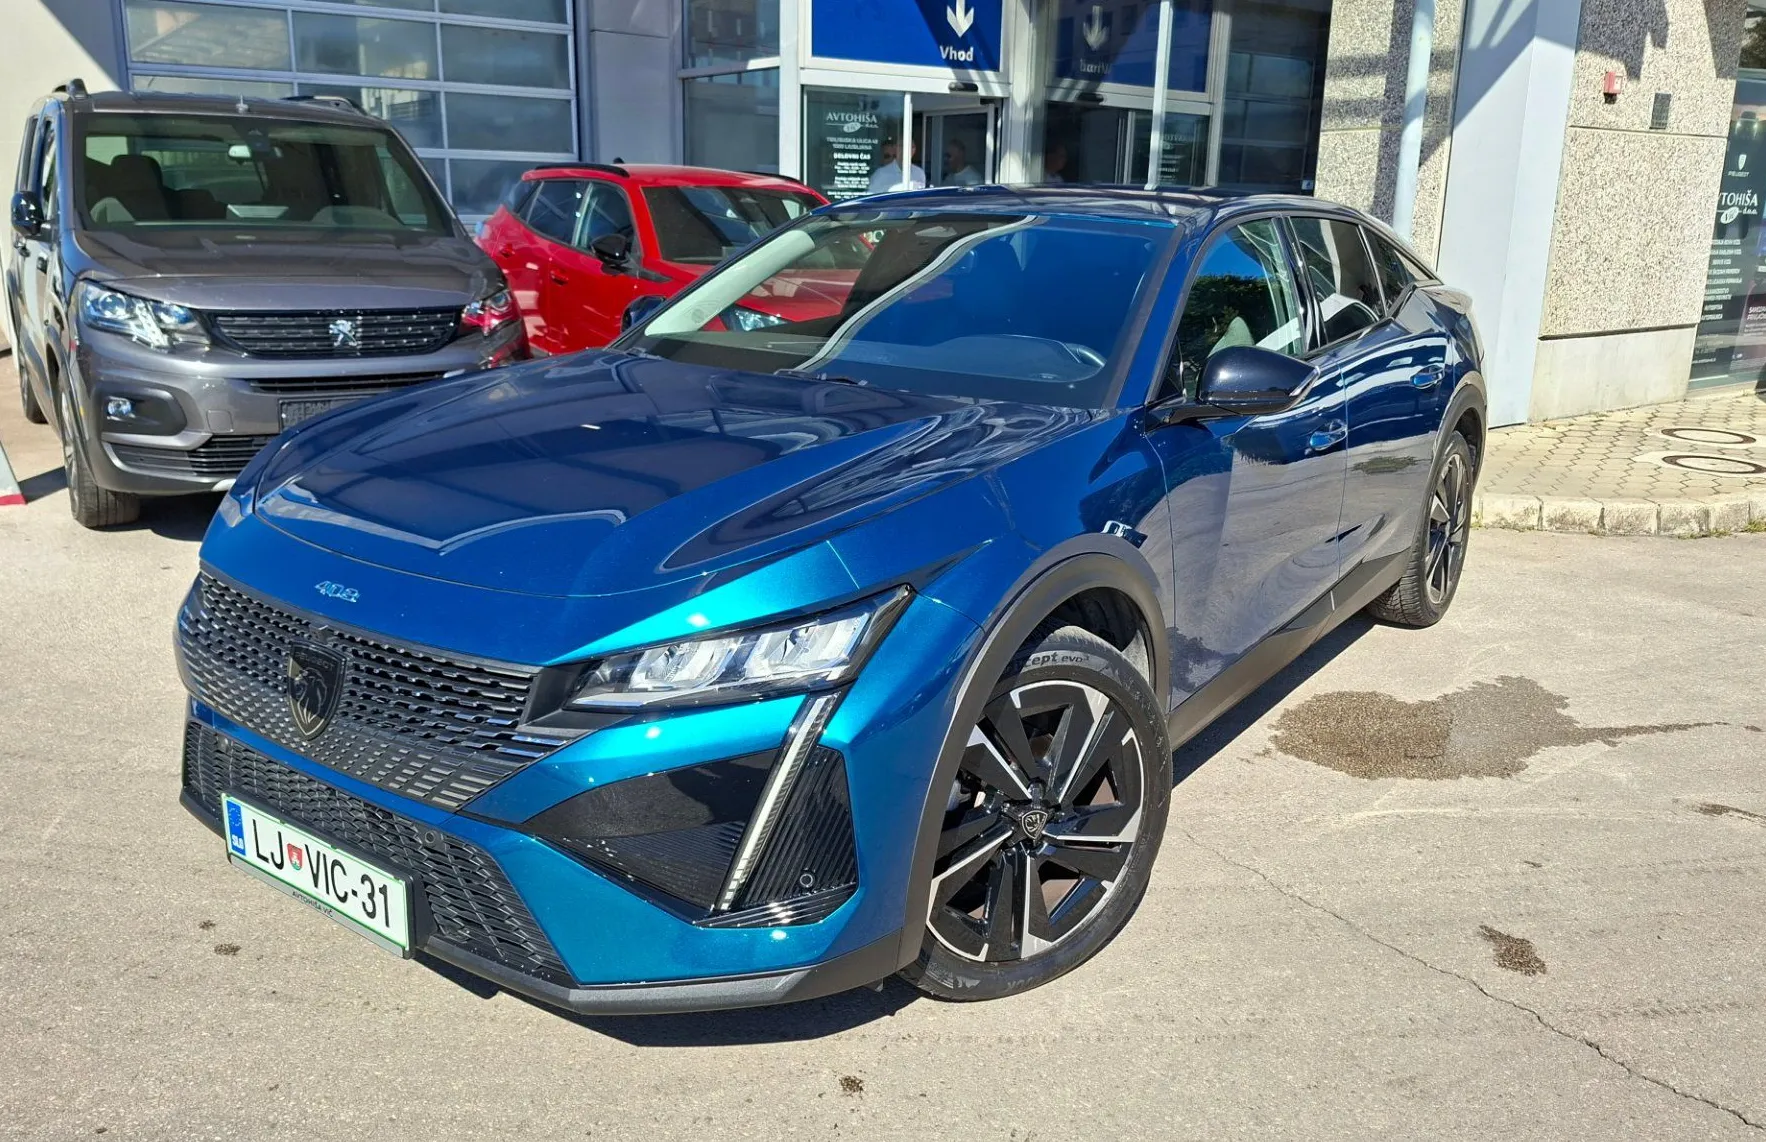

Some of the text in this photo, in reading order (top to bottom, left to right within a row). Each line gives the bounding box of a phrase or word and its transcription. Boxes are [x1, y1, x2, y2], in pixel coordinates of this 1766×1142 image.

[940, 45, 974, 61] Vhod
[826, 112, 877, 123] AVTOHIŠA
[1719, 189, 1758, 207] TOHIŠA
[314, 580, 360, 603] 408
[231, 834, 245, 850] SLO
[252, 818, 390, 928] LJ VIC-31
